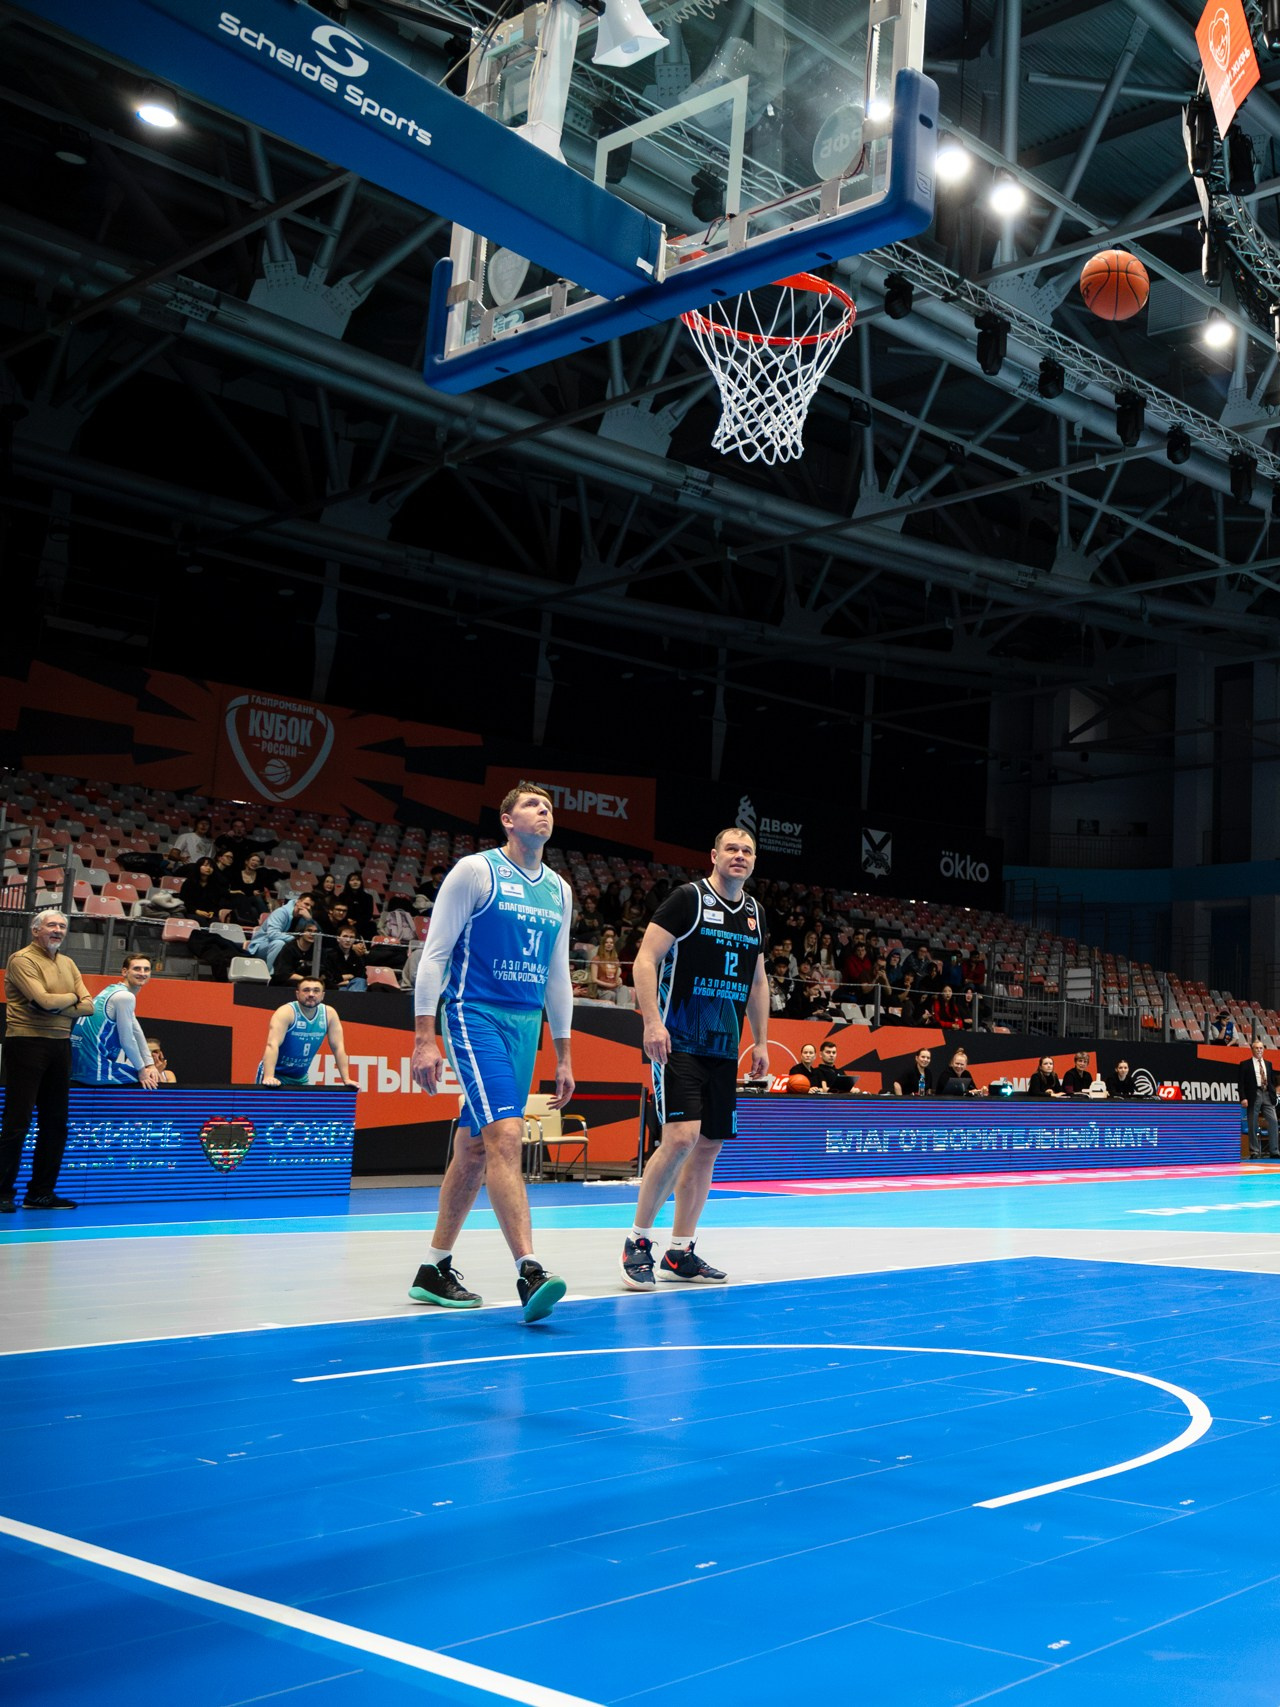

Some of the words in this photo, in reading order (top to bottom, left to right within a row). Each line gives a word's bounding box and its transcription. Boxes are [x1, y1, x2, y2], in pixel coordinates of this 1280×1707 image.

[218, 12, 338, 93] Schelde
[344, 84, 432, 146] Sports
[250, 695, 316, 715] ГАЗПРОМБАНК
[248, 708, 313, 747] КУБОК
[261, 741, 297, 758] РОССИИ
[759, 817, 802, 836] ДВФУ
[517, 914, 556, 927] МАТЧ
[522, 928, 543, 958] 31
[716, 938, 749, 950] МАТЧ
[724, 951, 738, 977] 12
[693, 986, 715, 996] КУБОК
[716, 989, 739, 1000] РОССИИ
[303, 1043, 311, 1057] 8
[1164, 1081, 1240, 1101] ЗПРОМБ
[825, 1121, 1100, 1153] БЛАГОТВОРИТЕЛЬНЫЙ
[1104, 1127, 1158, 1148] МАТЧ
